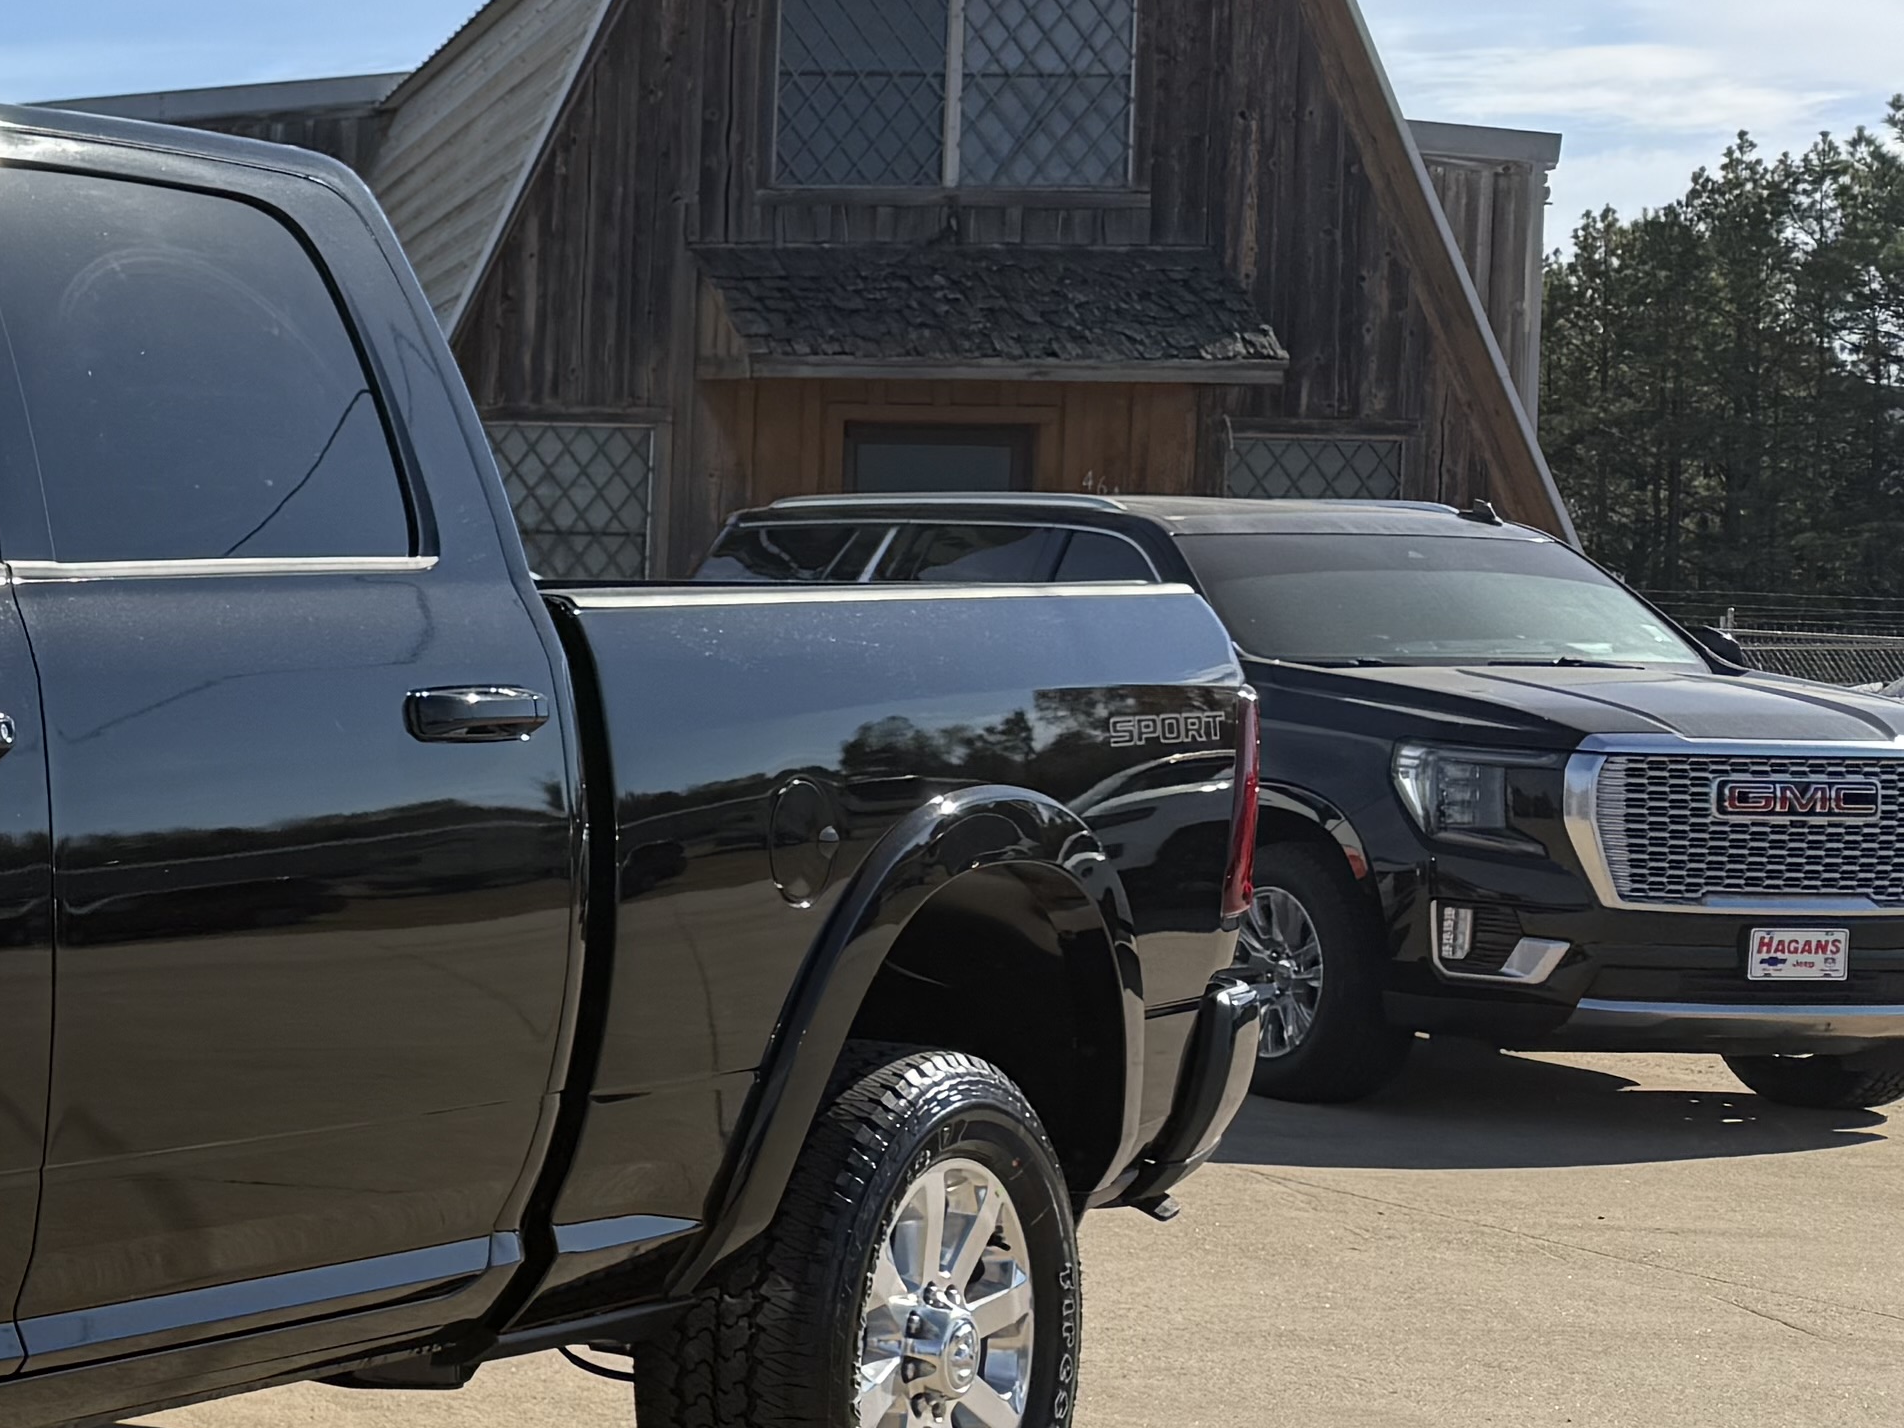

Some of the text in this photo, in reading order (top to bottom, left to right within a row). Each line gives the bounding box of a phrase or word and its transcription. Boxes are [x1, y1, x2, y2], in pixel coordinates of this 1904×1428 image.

[1109, 710, 1226, 747] SPORT
[1726, 782, 1877, 813] GMC
[1756, 935, 1842, 955] HAGANS
